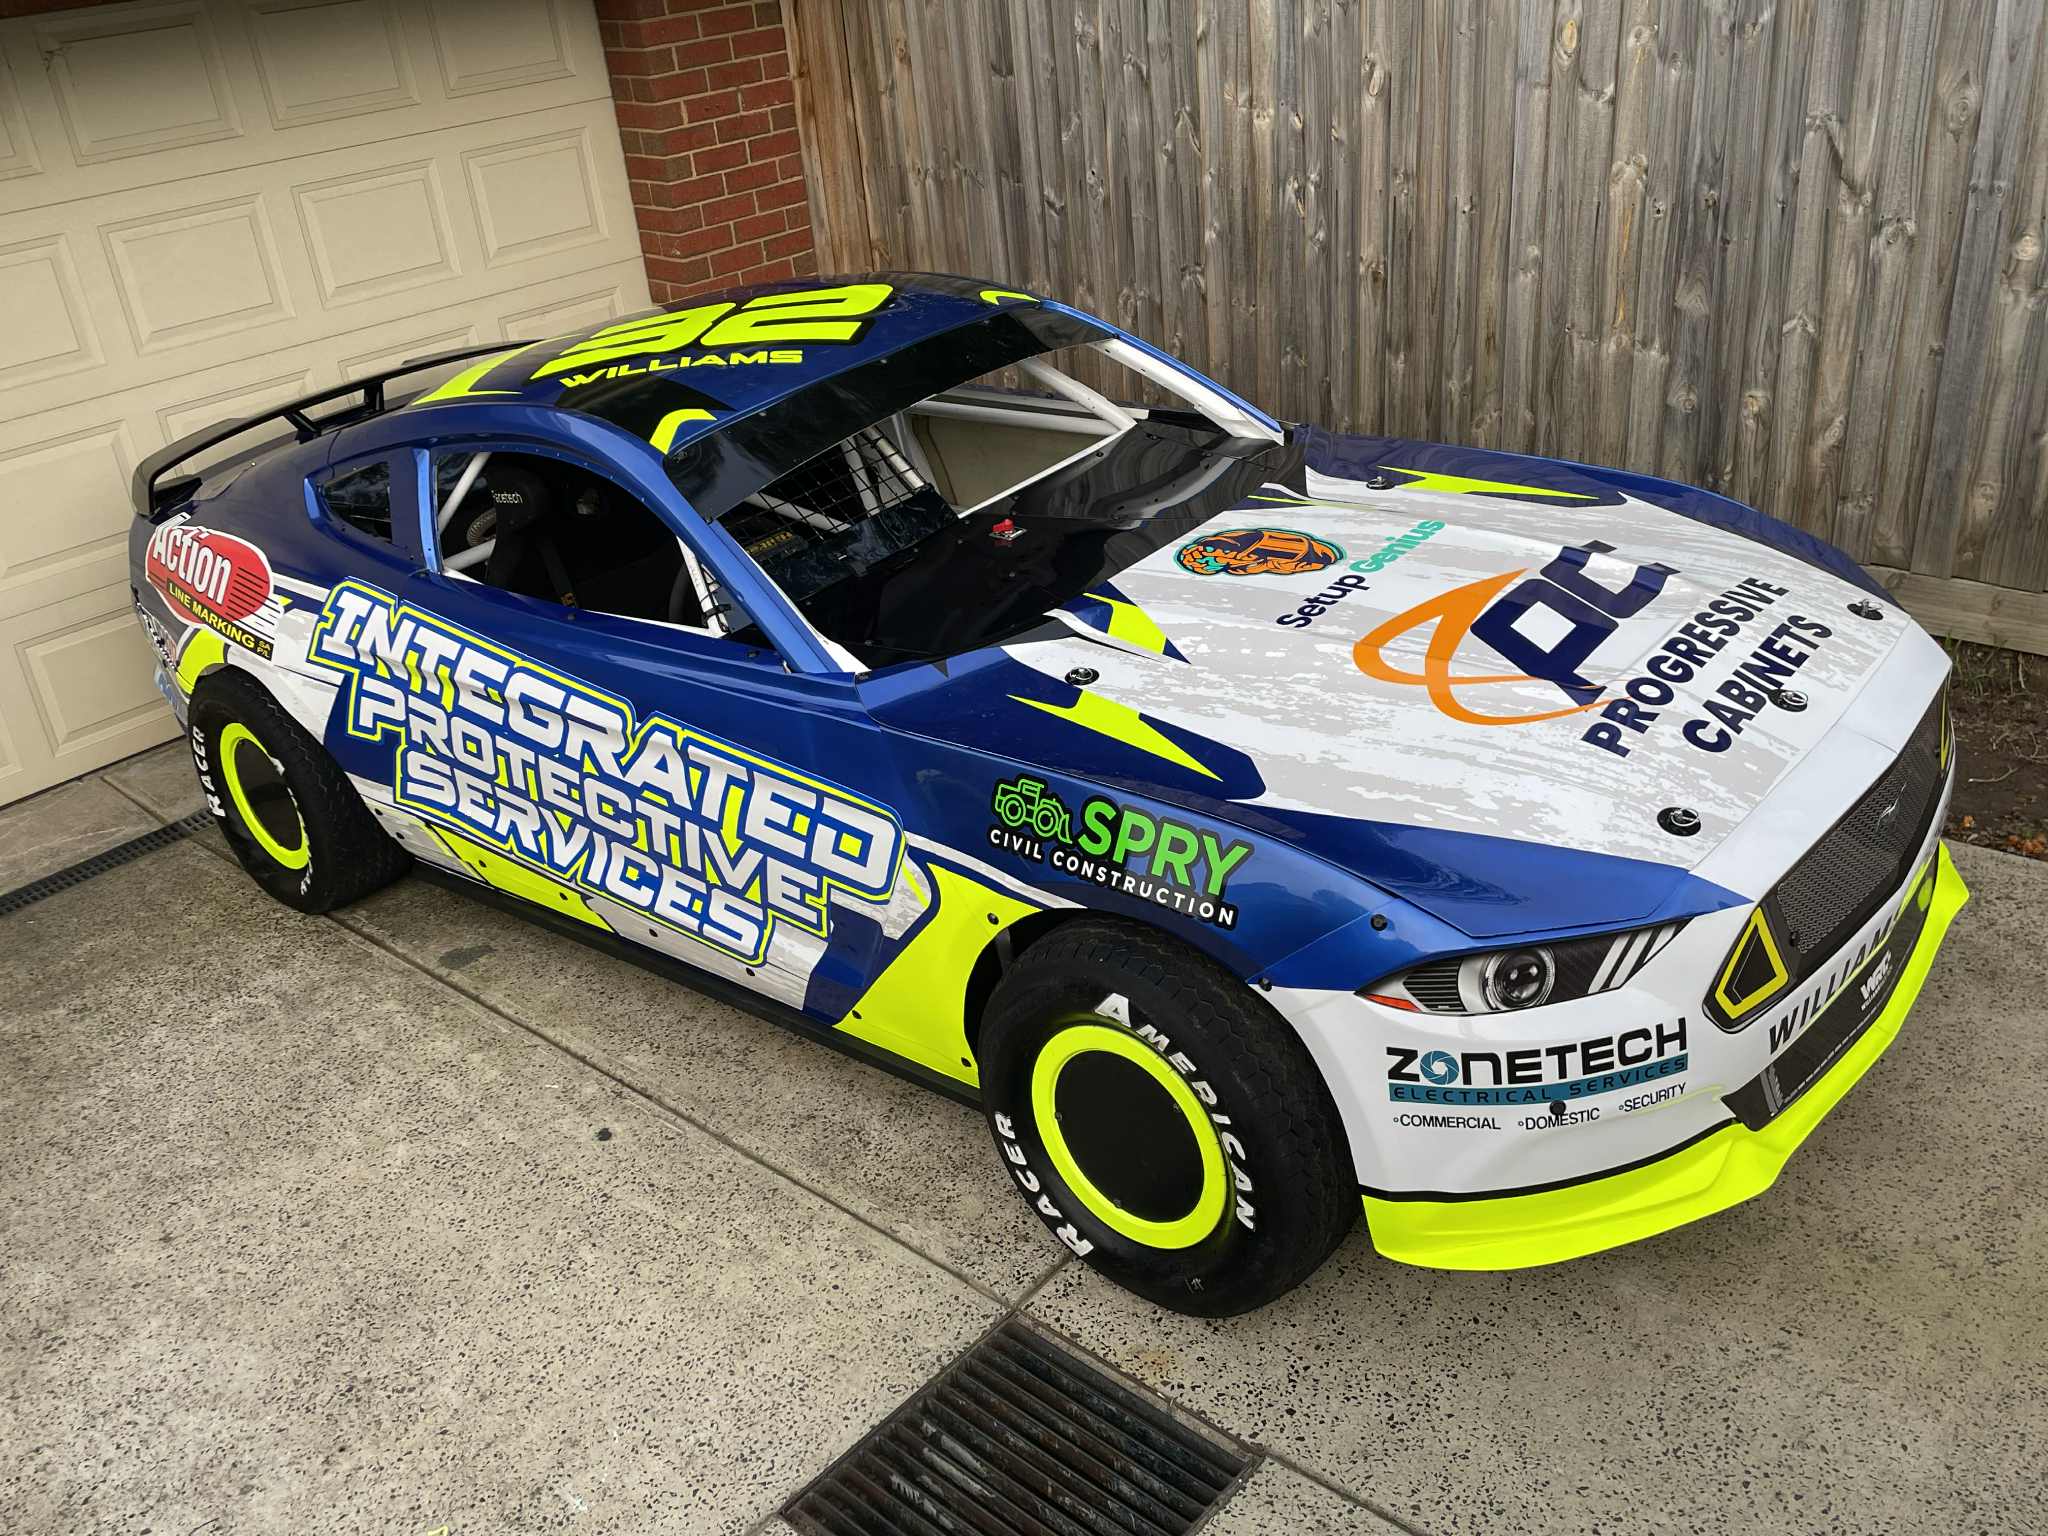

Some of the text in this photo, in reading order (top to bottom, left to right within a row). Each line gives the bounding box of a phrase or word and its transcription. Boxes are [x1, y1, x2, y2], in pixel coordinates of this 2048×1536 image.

[559, 349, 804, 389] WILLIAMS
[151, 513, 233, 606] Action
[1275, 518, 1447, 629] Setup Genius
[167, 583, 192, 610] LINE
[192, 602, 256, 650] MARKING
[1580, 576, 1790, 758] PROGRESSIVE
[1681, 614, 1834, 753] CABINETS
[191, 724, 227, 818] RACER
[317, 586, 901, 892] INTEGRATED
[358, 676, 822, 922] PROTECTIVE
[1077, 801, 1250, 897] SPRY
[404, 746, 764, 957] SERVICES
[989, 829, 1236, 926] CIVIL CONSTRUCTION
[1385, 1016, 1688, 1086] ZONETECH
[1392, 1056, 1688, 1104] ELECTRICAL SERVICES
[1094, 992, 1258, 1231] AMERICAN
[994, 1111, 1095, 1258] RACER
